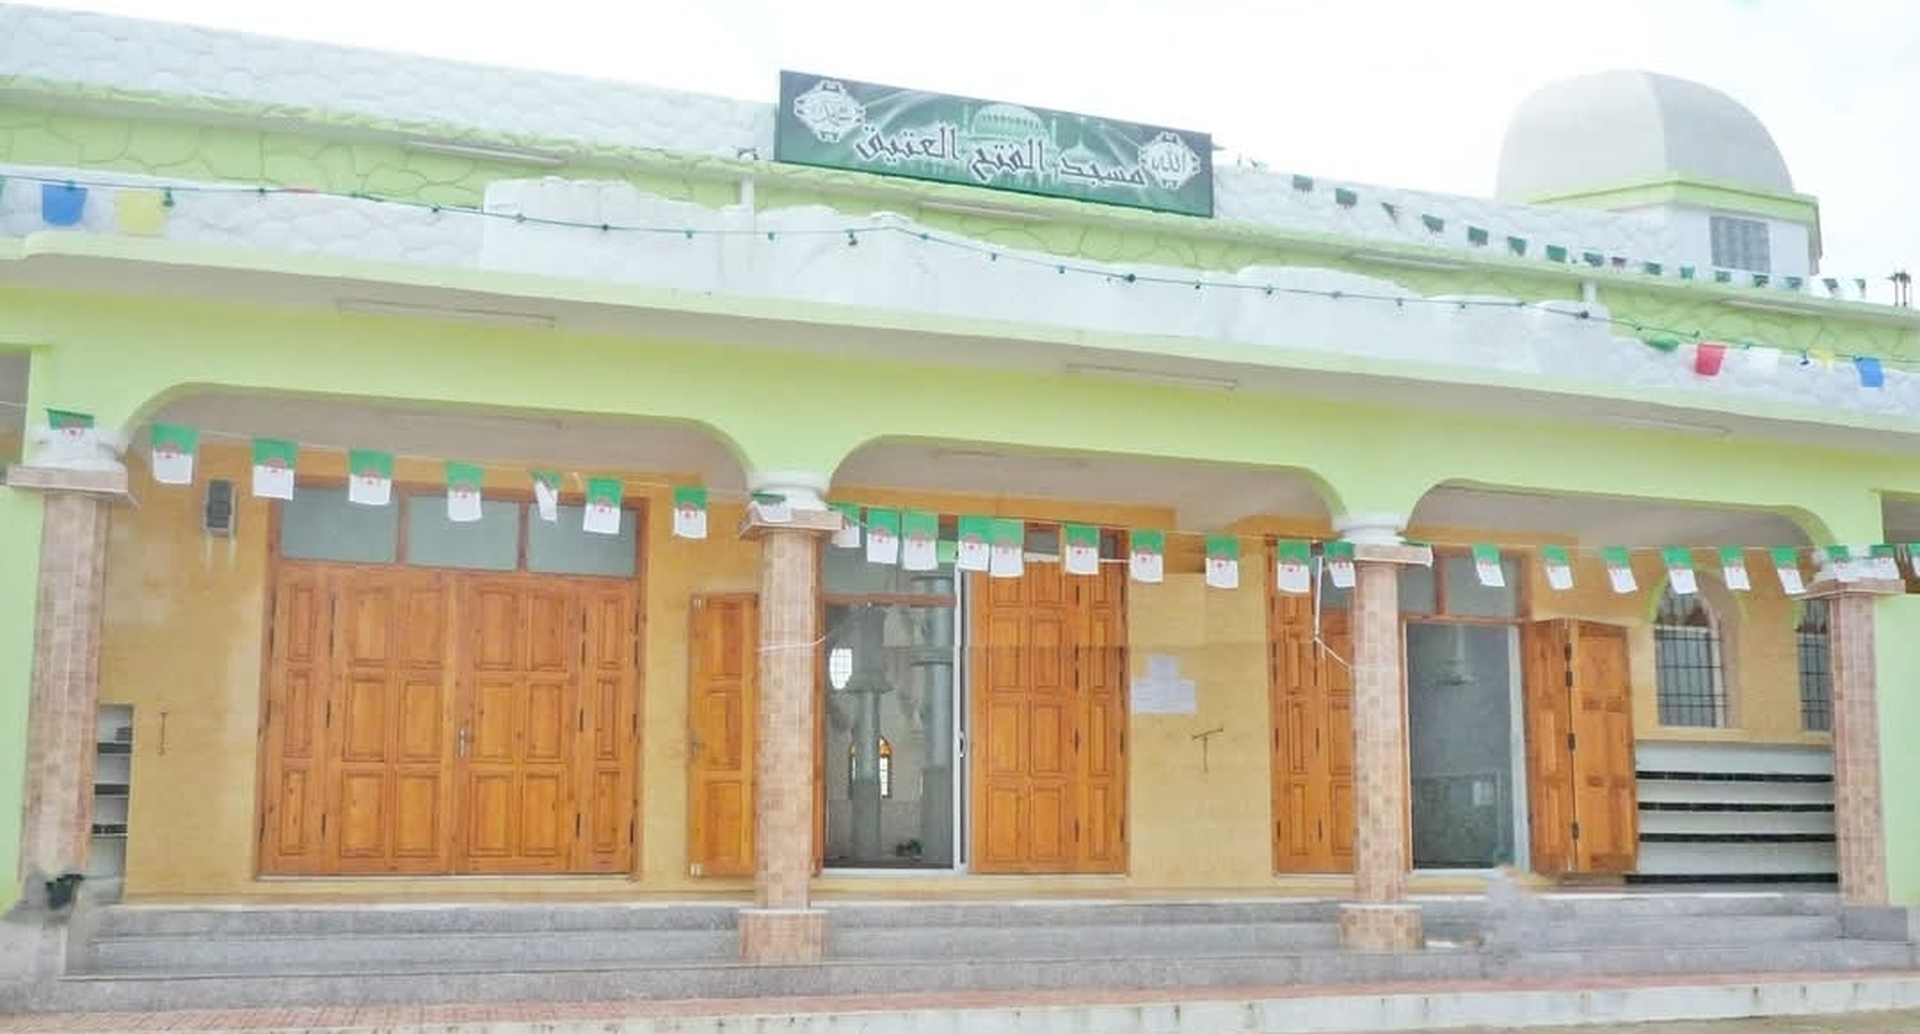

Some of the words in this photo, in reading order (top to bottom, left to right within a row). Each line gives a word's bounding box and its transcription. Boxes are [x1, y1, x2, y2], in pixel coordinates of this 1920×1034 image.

[855, 124, 957, 163] العتيق
[968, 137, 1045, 181] الفتح
[1060, 157, 1145, 186] مسجد
